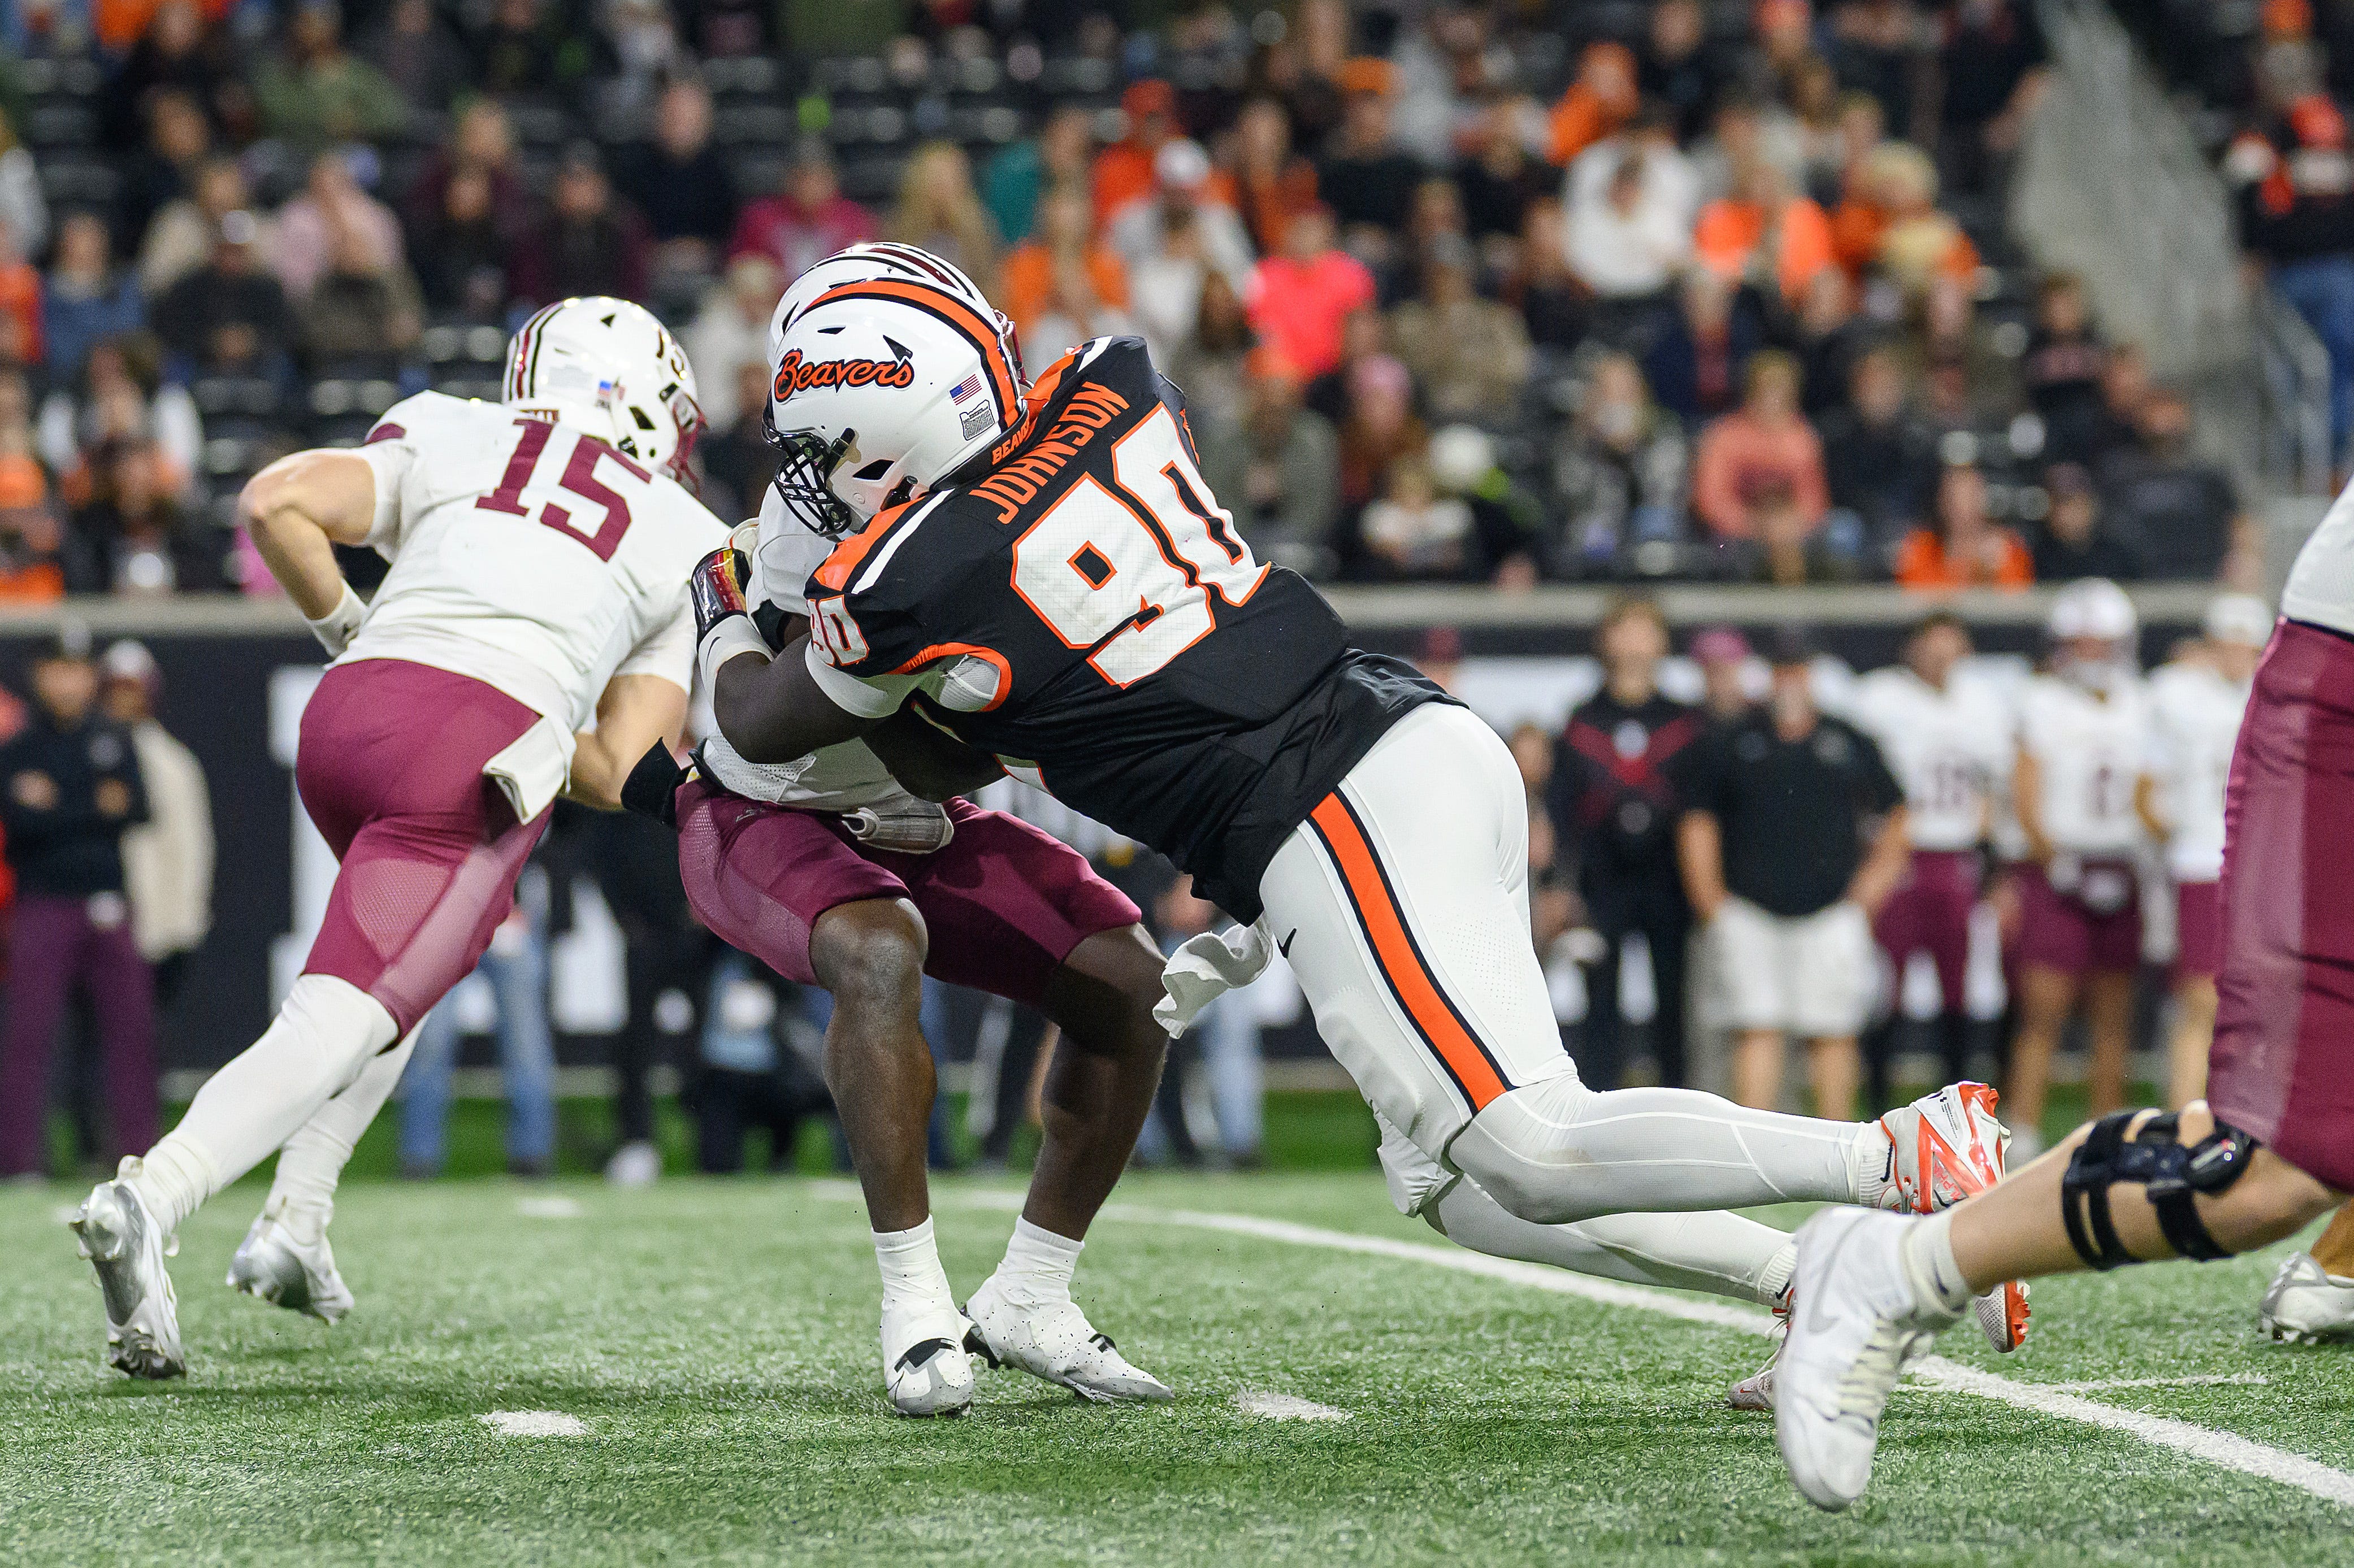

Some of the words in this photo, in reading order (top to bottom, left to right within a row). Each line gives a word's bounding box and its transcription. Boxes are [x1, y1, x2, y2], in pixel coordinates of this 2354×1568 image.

[774, 348, 914, 402] Beavers
[475, 419, 652, 563] 15
[968, 381, 1130, 524] JOHNSON
[1010, 401, 1271, 689] 90
[807, 594, 870, 666] 90
